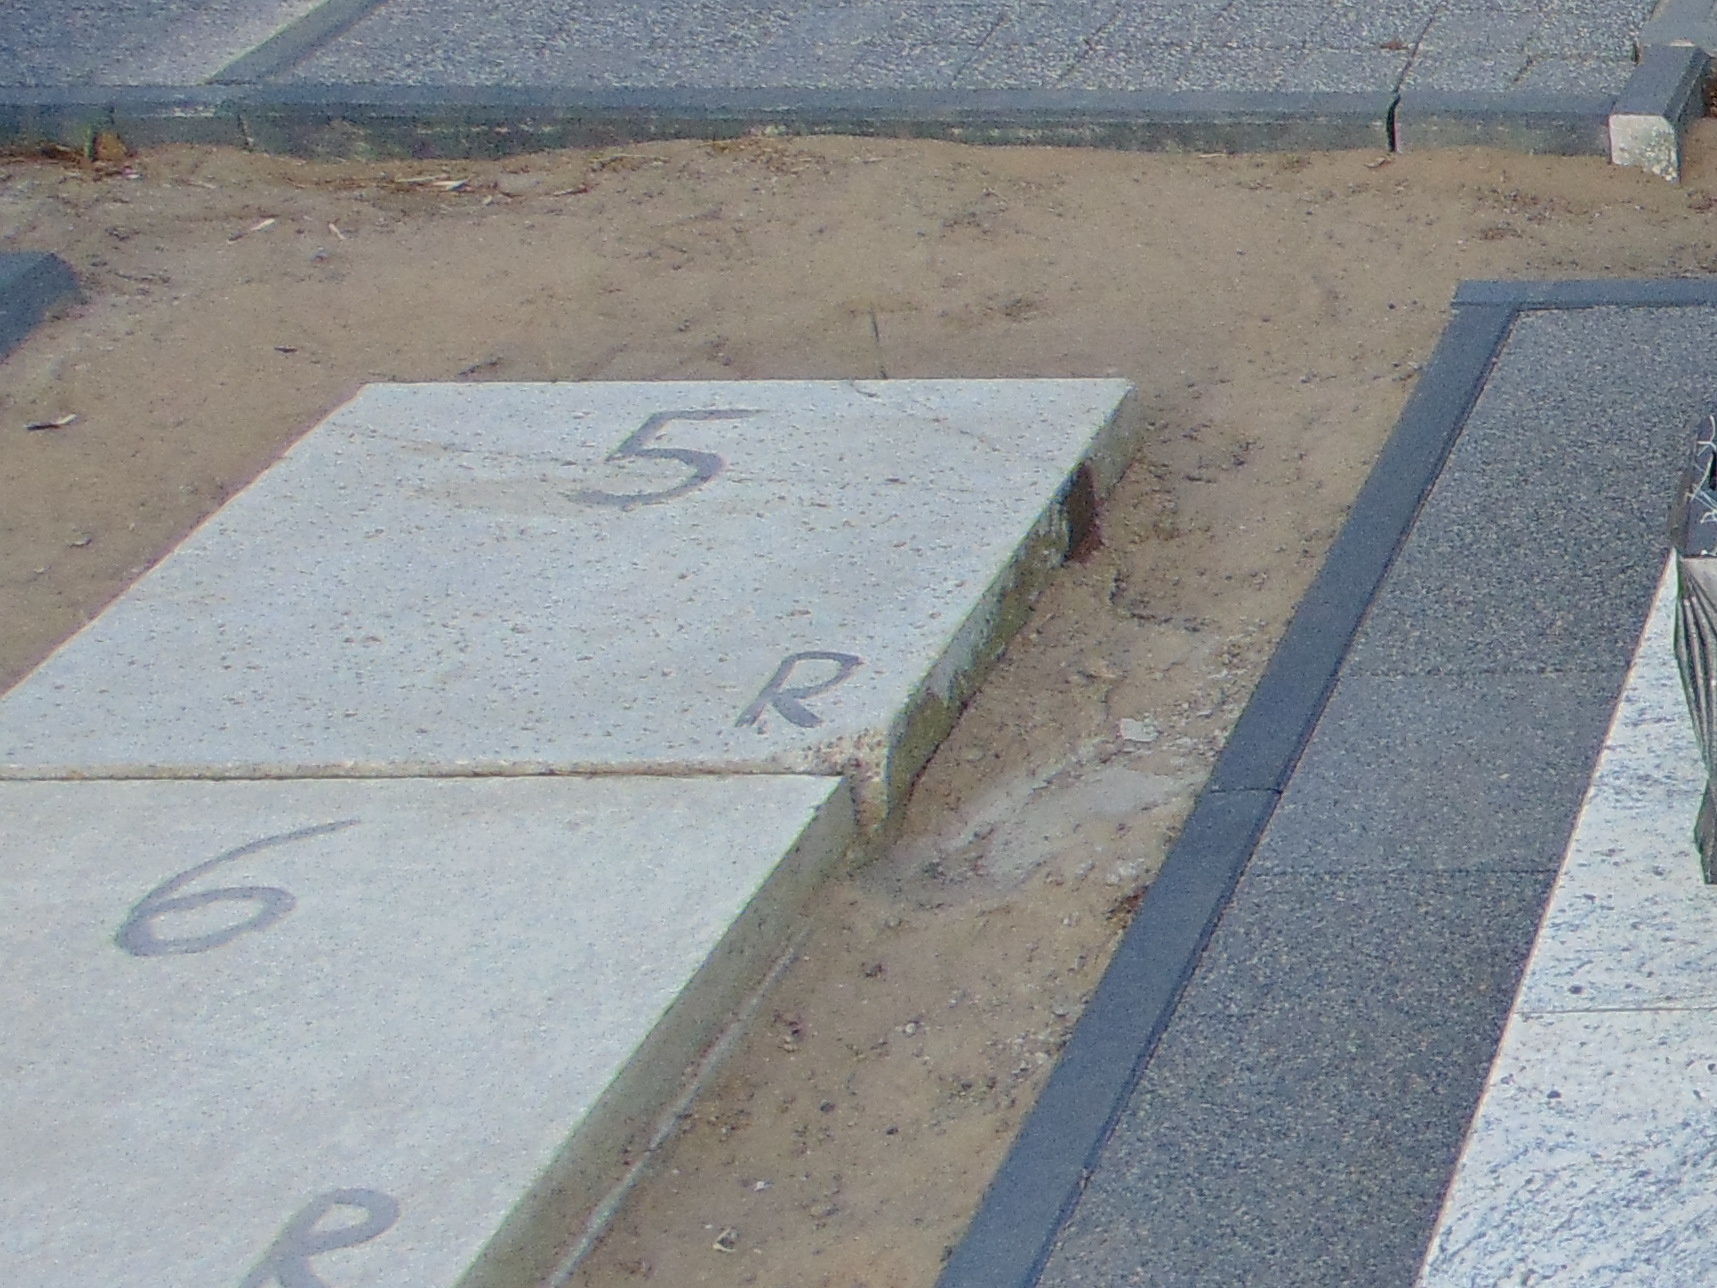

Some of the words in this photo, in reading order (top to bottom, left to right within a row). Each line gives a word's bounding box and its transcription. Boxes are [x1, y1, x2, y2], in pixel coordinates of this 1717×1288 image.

[570, 408, 772, 508] 5
[734, 650, 863, 730] R
[112, 818, 360, 958] 6
